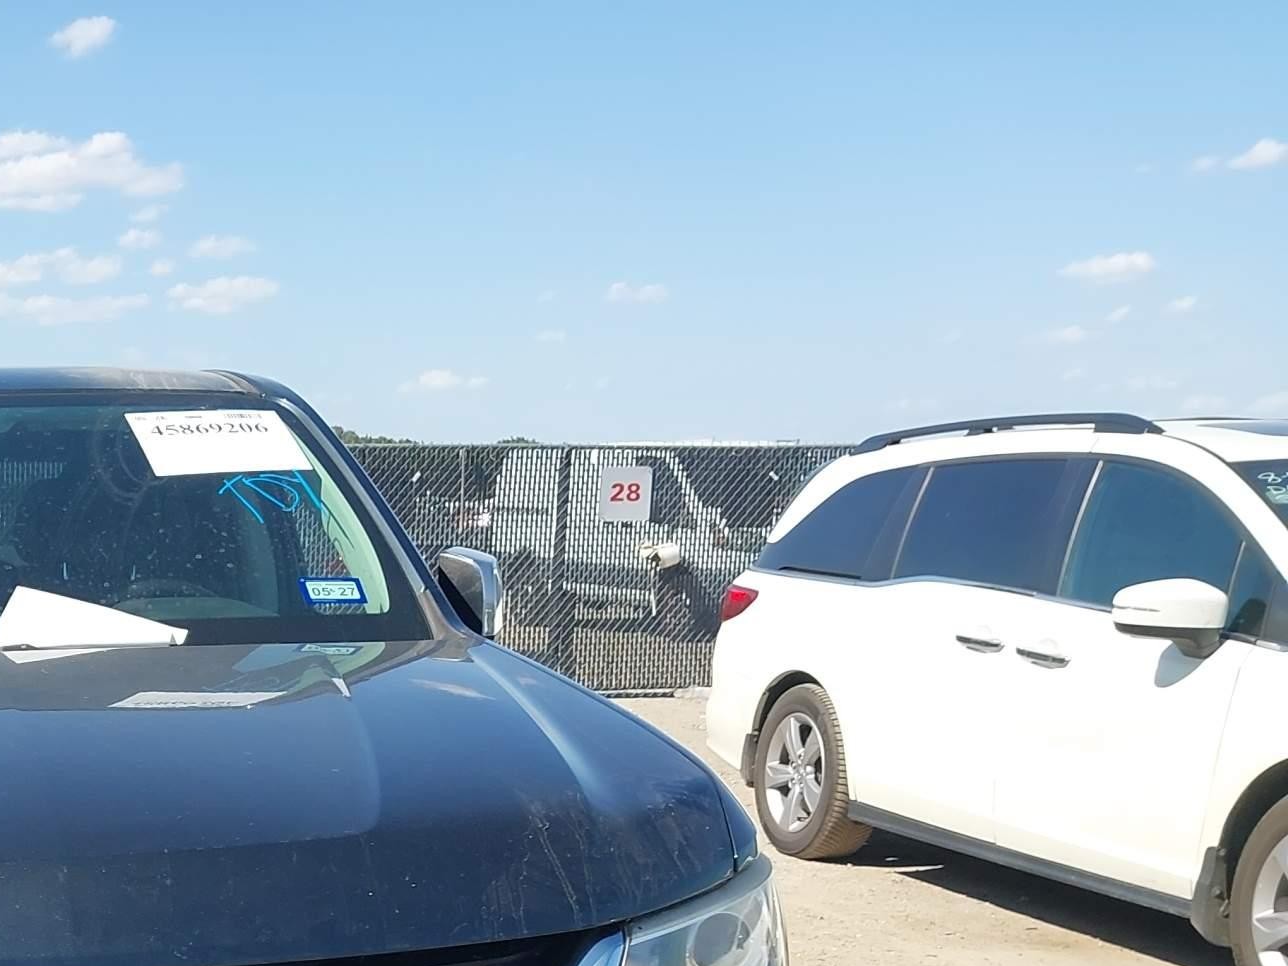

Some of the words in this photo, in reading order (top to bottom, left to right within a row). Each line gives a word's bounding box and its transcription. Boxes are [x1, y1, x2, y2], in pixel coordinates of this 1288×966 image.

[150, 421, 269, 436] 45869206
[609, 483, 641, 502] 28
[312, 587, 331, 597] 05
[337, 587, 355, 597] 27
